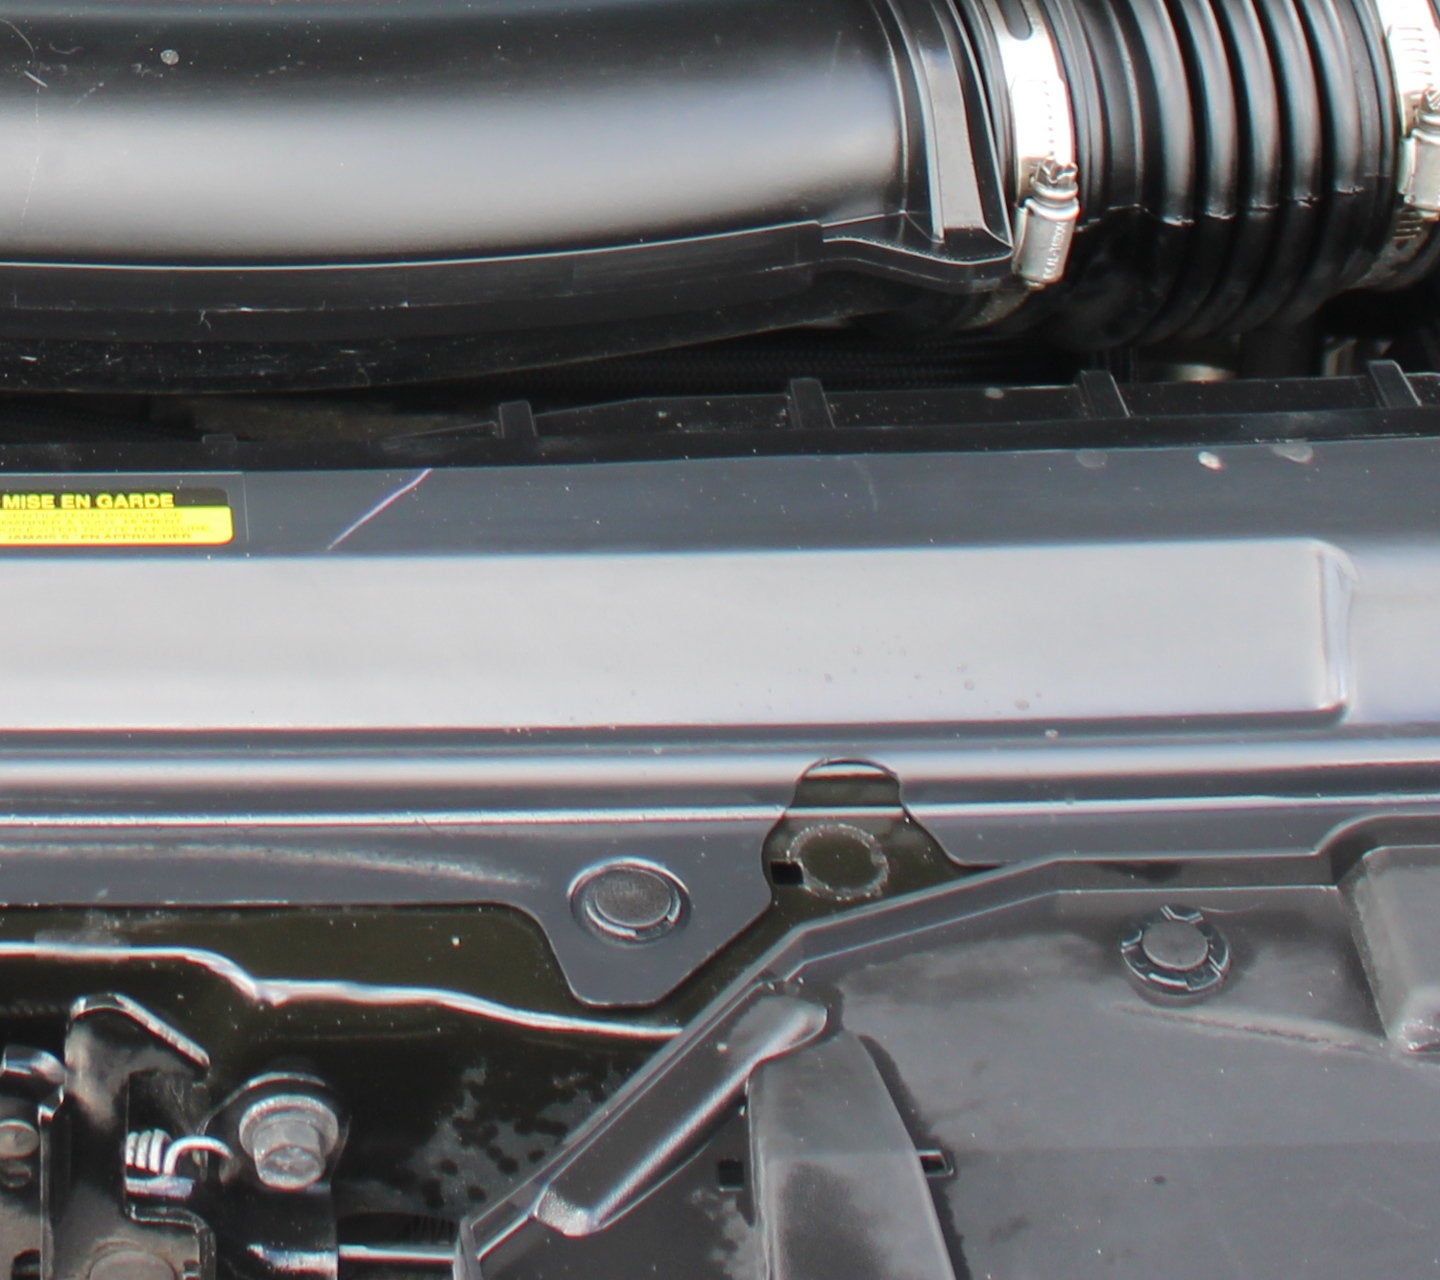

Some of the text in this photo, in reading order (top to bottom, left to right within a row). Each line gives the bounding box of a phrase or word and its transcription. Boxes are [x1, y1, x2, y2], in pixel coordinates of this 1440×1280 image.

[2, 492, 175, 510] MISE EN GARDE
